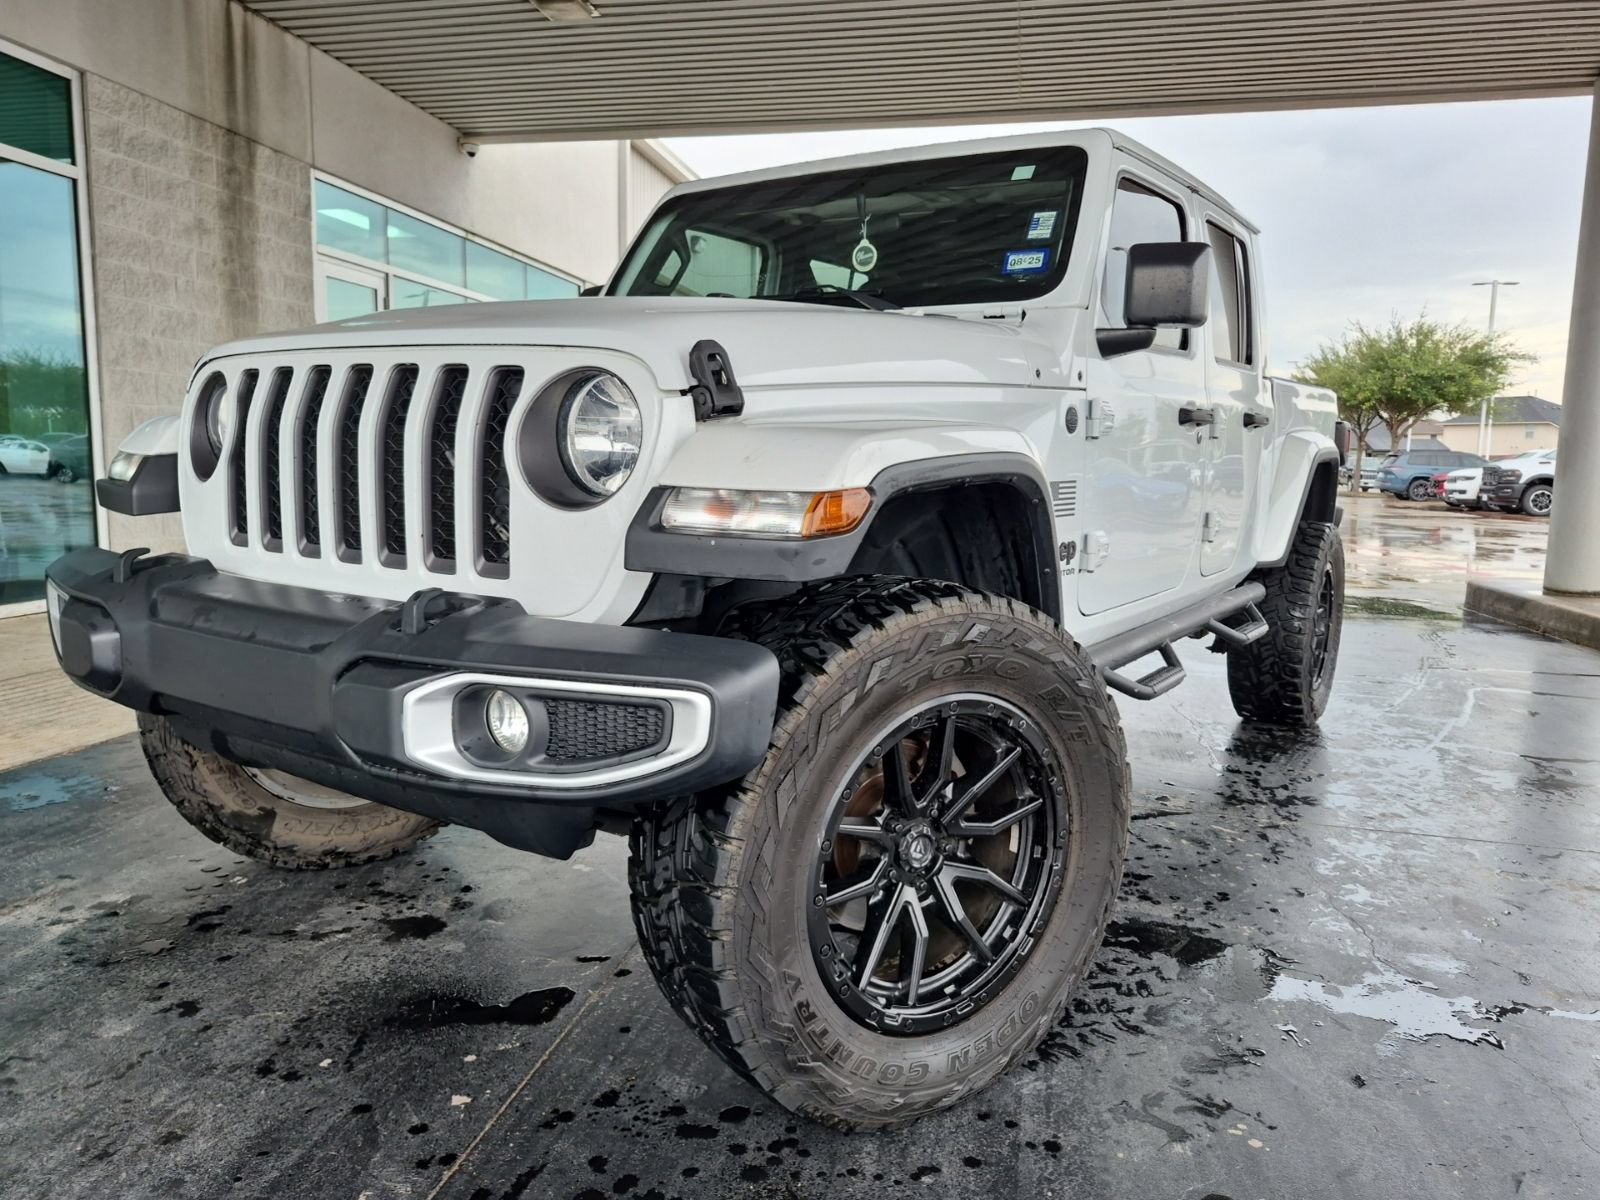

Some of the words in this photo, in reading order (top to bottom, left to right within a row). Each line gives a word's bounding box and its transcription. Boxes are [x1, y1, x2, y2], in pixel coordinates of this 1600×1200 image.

[1009, 257, 1023, 267] 08
[1028, 255, 1042, 265] 25
[1059, 540, 1077, 566] ep
[901, 653, 1031, 693] TOYO
[783, 968, 931, 1087] COUNTRY
[946, 990, 1040, 1077] OPEN
